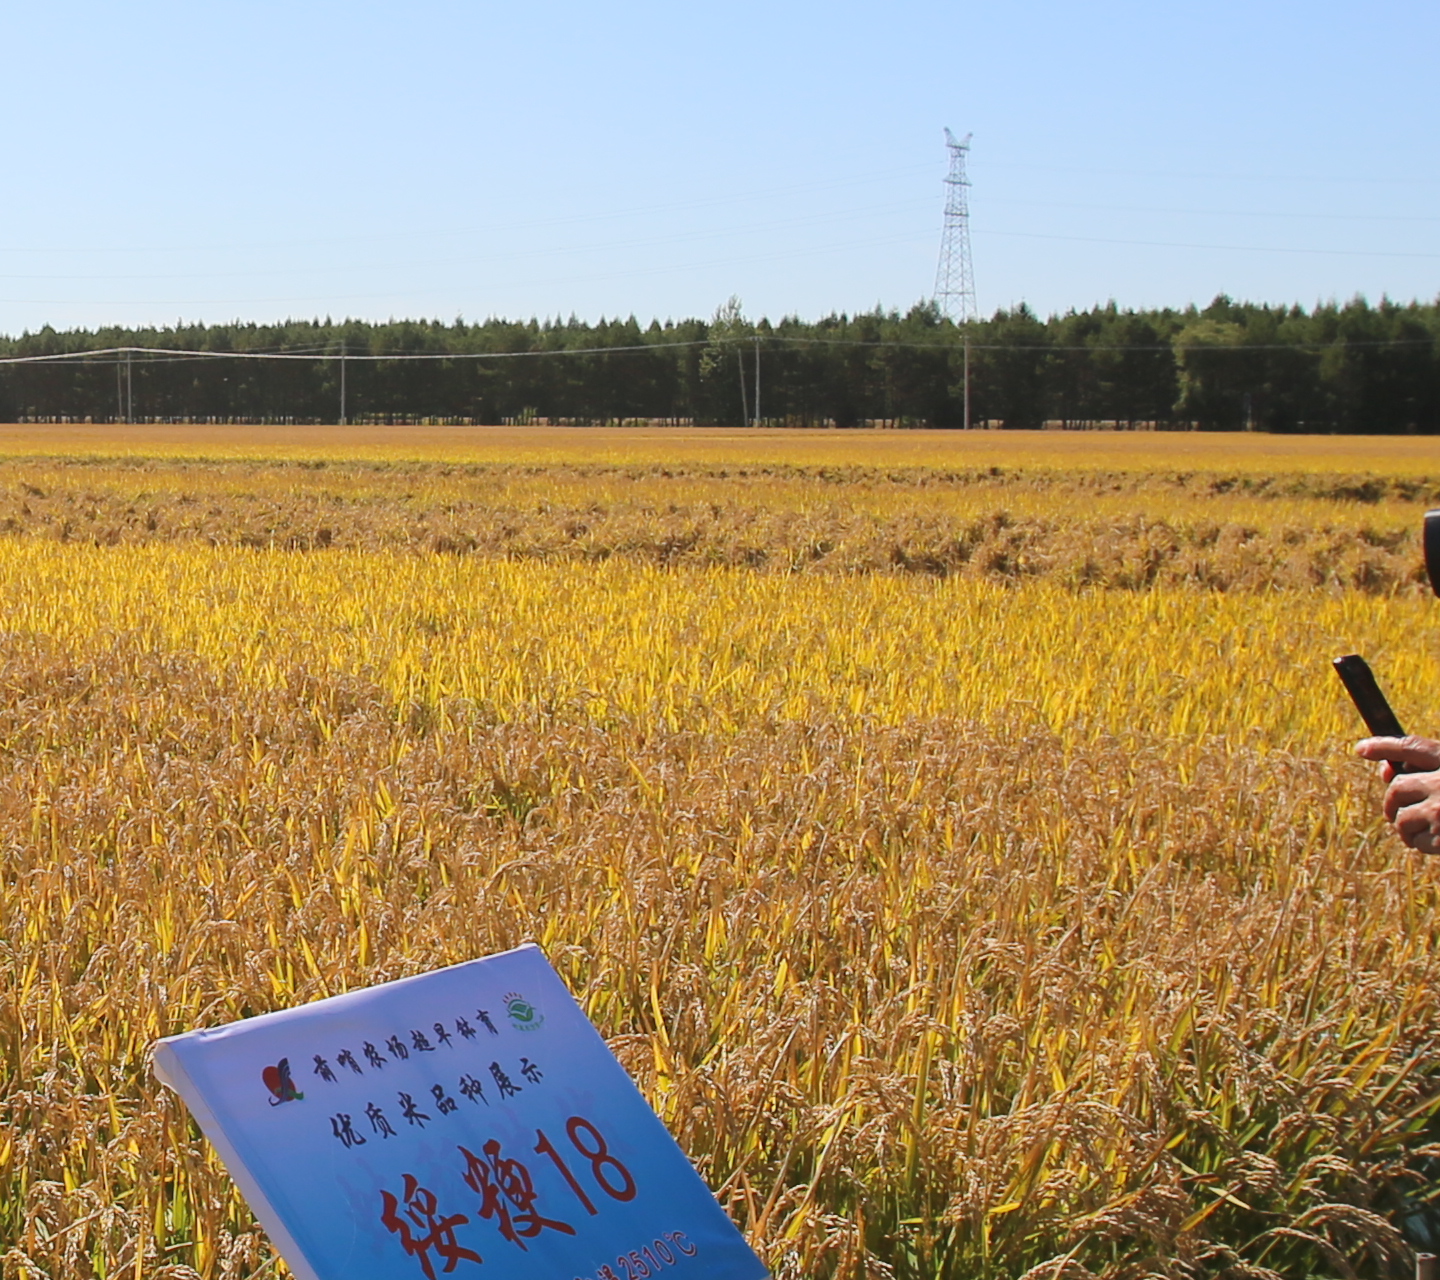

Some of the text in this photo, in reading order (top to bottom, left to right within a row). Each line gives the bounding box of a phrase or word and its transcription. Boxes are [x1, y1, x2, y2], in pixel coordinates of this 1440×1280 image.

[329, 1057, 543, 1149] 优质米品种展示
